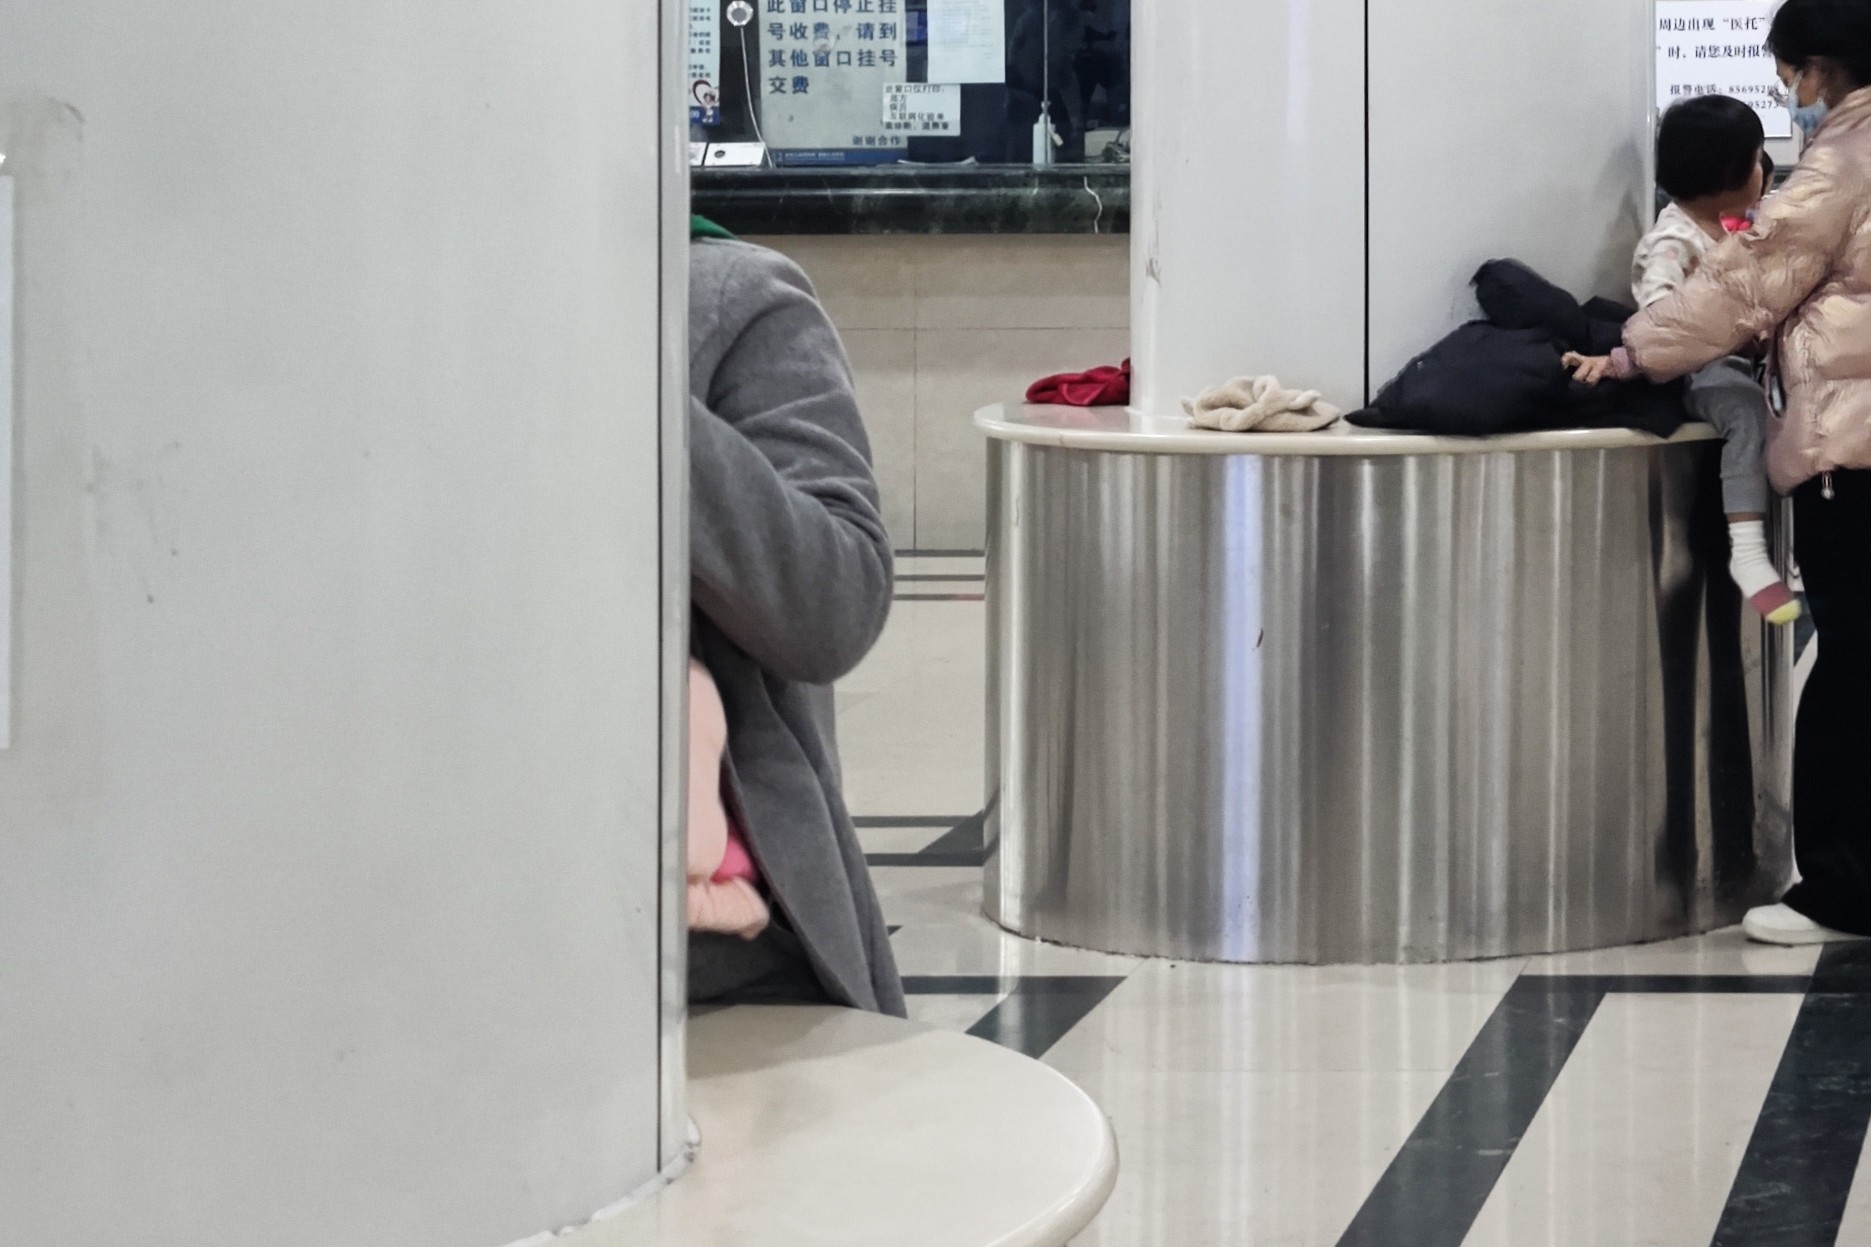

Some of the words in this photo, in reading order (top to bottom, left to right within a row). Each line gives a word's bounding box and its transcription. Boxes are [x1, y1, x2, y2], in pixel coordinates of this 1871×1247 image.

[767, 22, 897, 41] 号收费，请到
[768, 48, 897, 67] 其他窗口挂号
[768, 75, 810, 94] 交费
[853, 135, 901, 146] 谢谢合作
